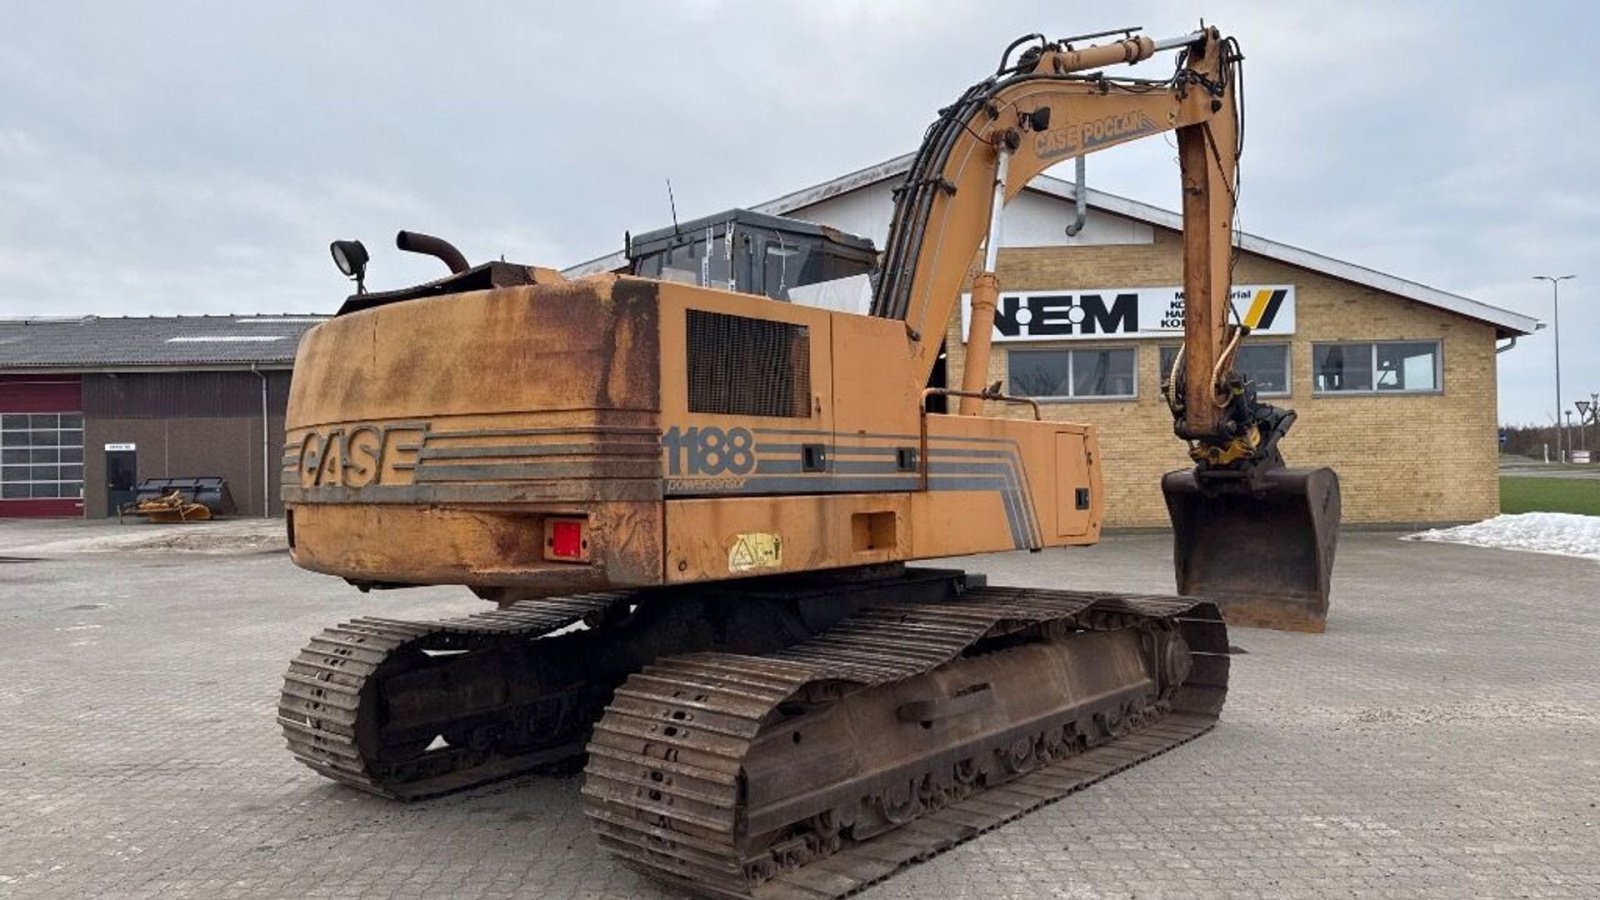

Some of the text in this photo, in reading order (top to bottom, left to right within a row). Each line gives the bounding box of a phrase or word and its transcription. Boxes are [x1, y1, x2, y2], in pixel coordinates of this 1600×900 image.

[1034, 109, 1145, 157] CASE POCLAIN
[299, 424, 427, 488] CASE
[661, 426, 755, 476] 1188
